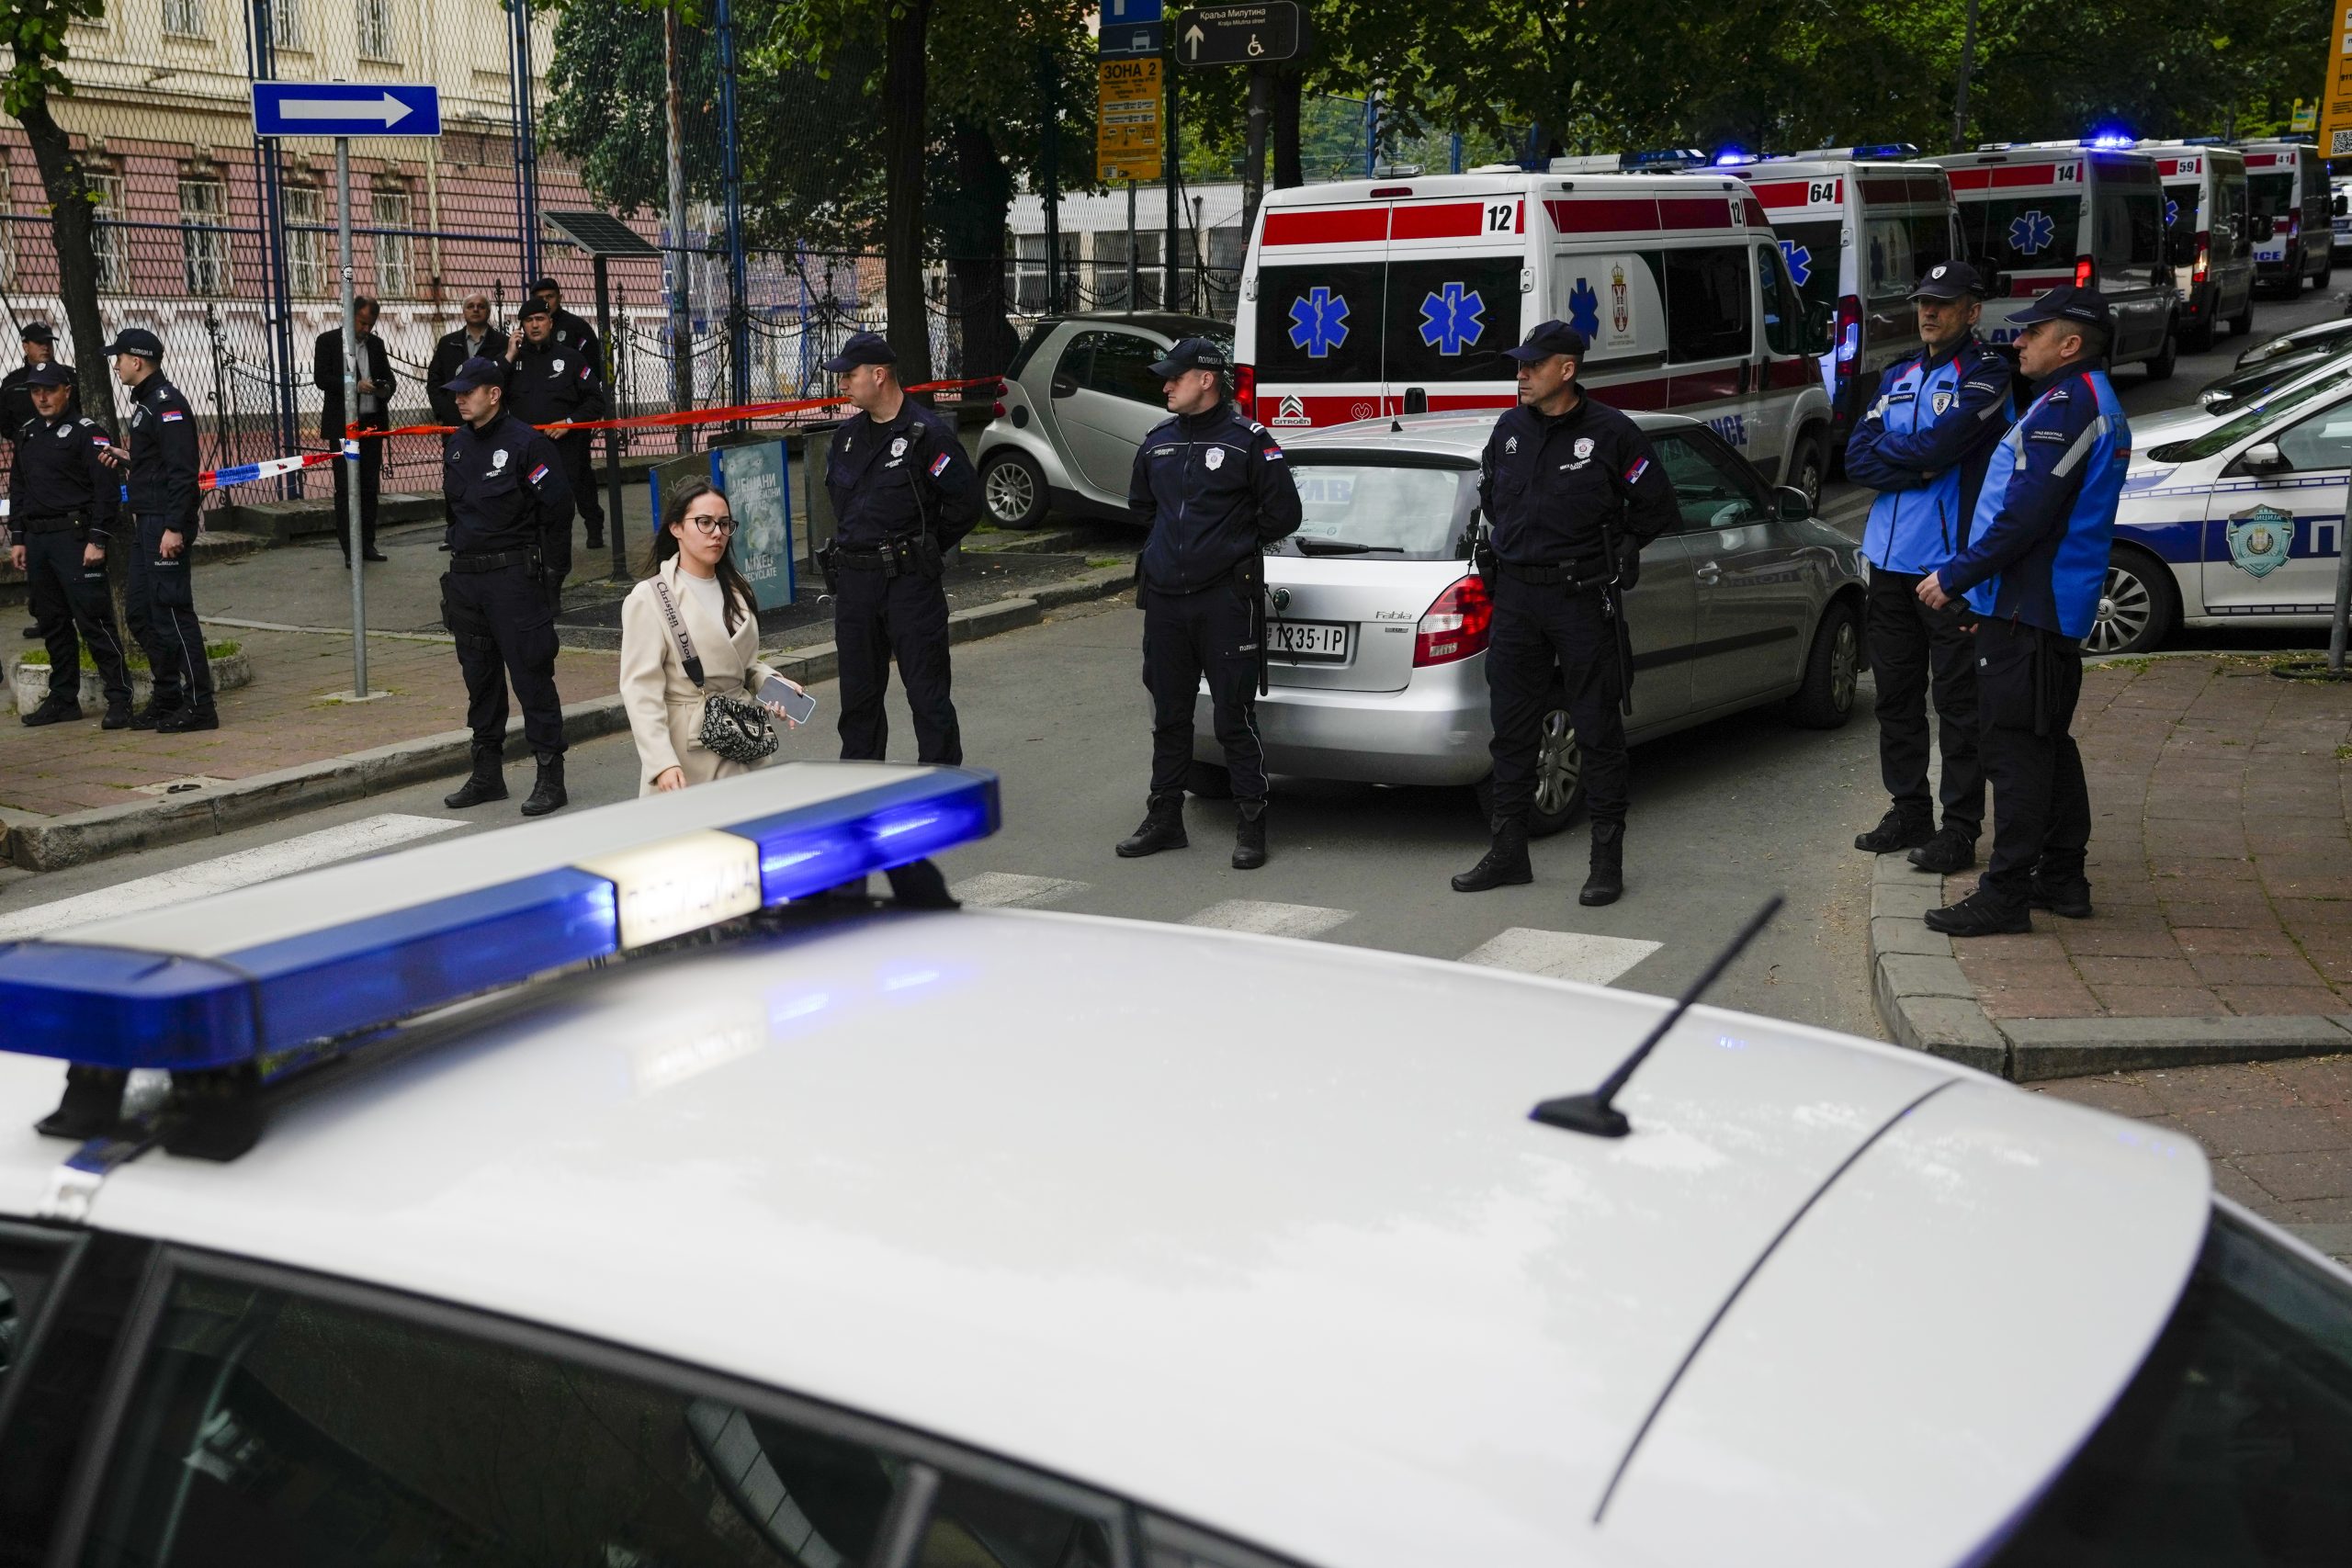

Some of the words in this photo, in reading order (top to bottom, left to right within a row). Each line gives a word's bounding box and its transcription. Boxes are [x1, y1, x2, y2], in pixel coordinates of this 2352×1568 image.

[1227, 8, 1266, 18] Милутина
[1148, 62, 1157, 76] 2
[2178, 161, 2194, 174] 59
[2277, 155, 2290, 164] 41
[2057, 165, 2075, 181] 14
[1810, 183, 1834, 203] 64
[1487, 205, 1512, 231] 12
[1730, 201, 1742, 224] 12
[744, 553, 774, 571] MIXED
[656, 581, 680, 626] Christian
[1375, 611, 1412, 619] Fabia
